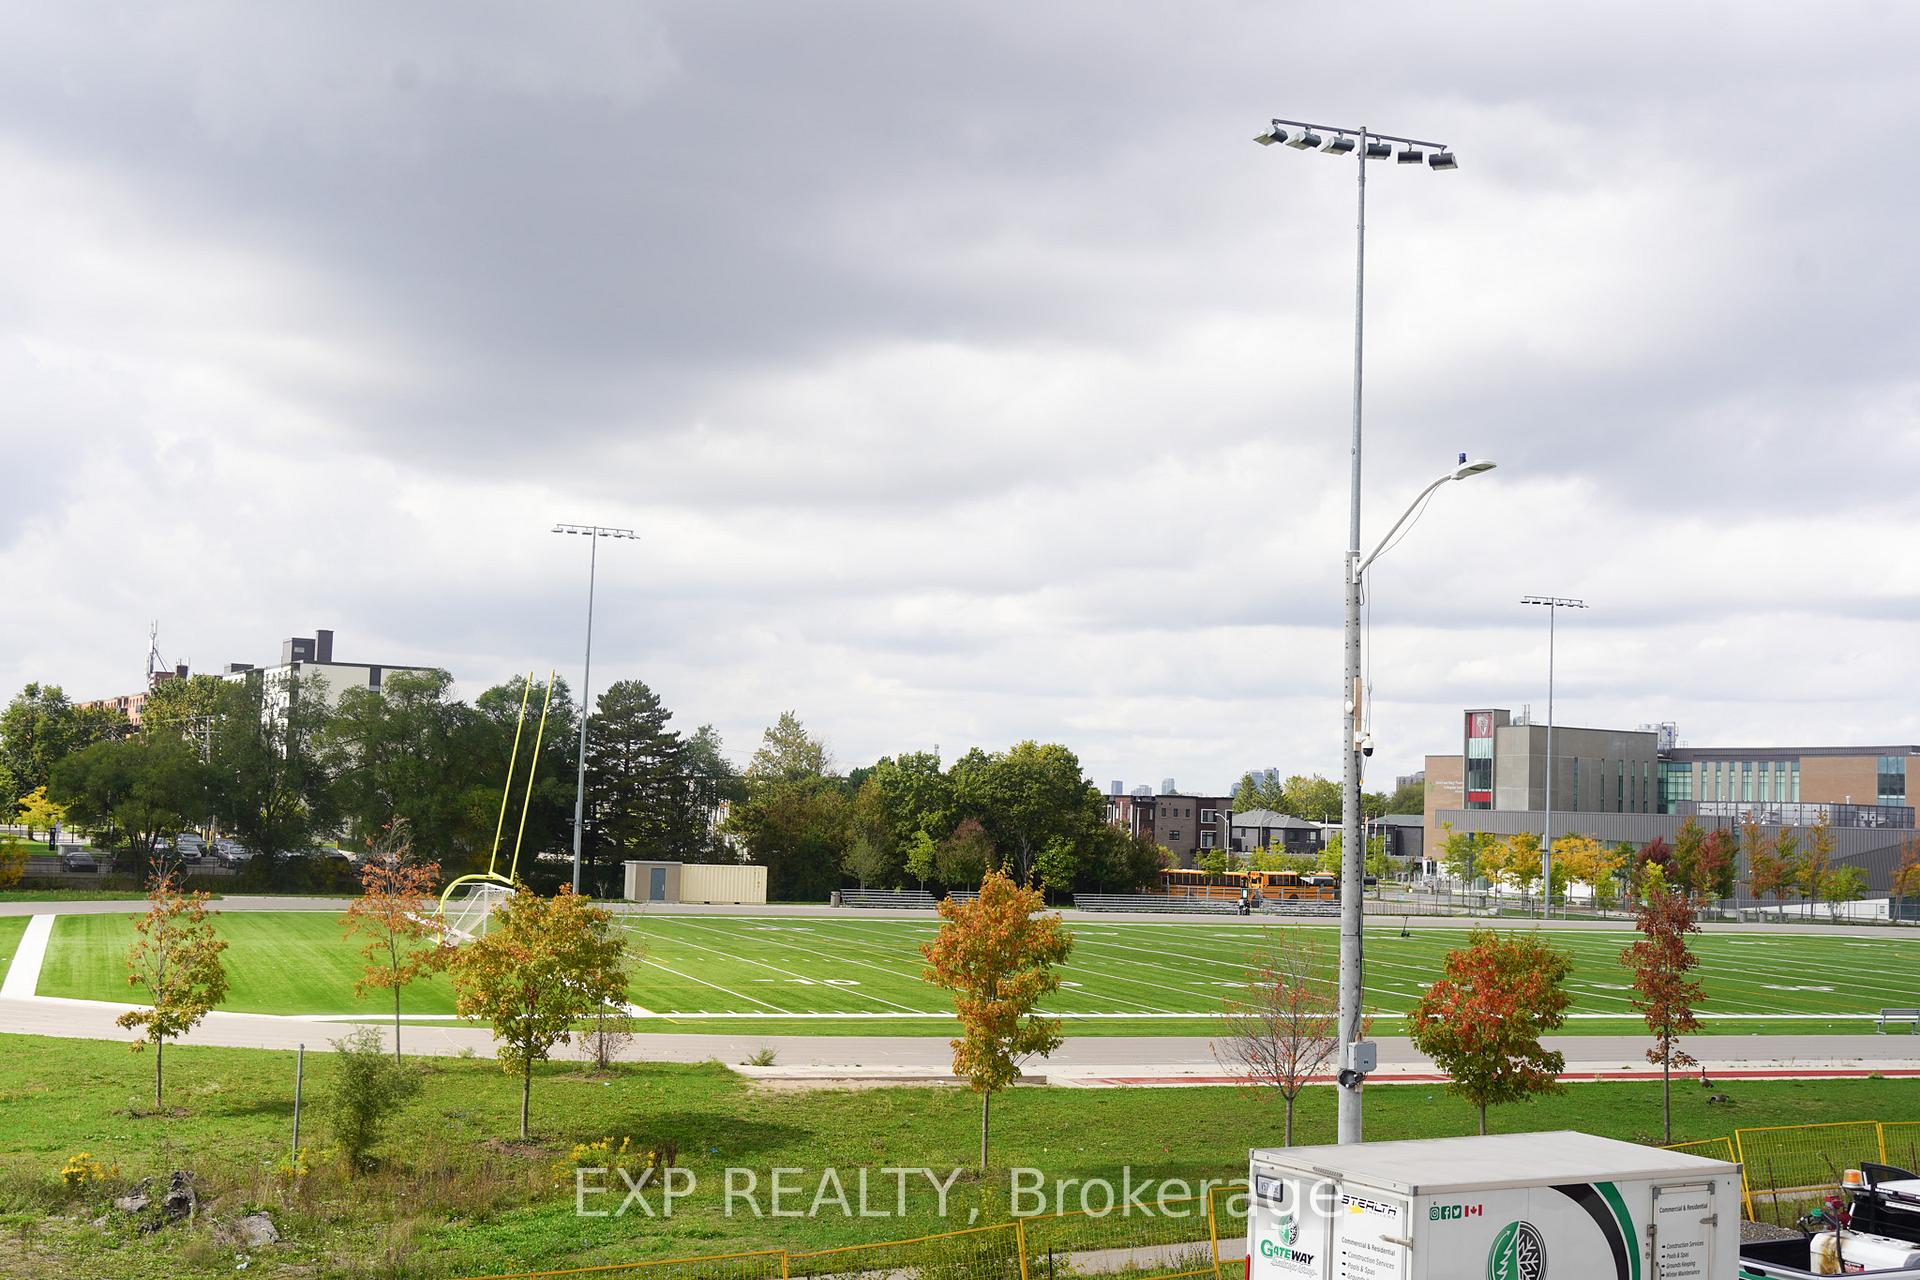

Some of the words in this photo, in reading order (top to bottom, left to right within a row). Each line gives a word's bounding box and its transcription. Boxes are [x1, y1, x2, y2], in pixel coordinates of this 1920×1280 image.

[1341, 1194, 1397, 1216] STEALTH
[1659, 1204, 1682, 1213] Commercial
[1687, 1202, 1708, 1211] Residential
[1260, 1239, 1315, 1265] GATEWAY
[1341, 1237, 1367, 1249] Commercial
[1371, 1244, 1396, 1256] Residential
[1375, 1258, 1395, 1270] Services
